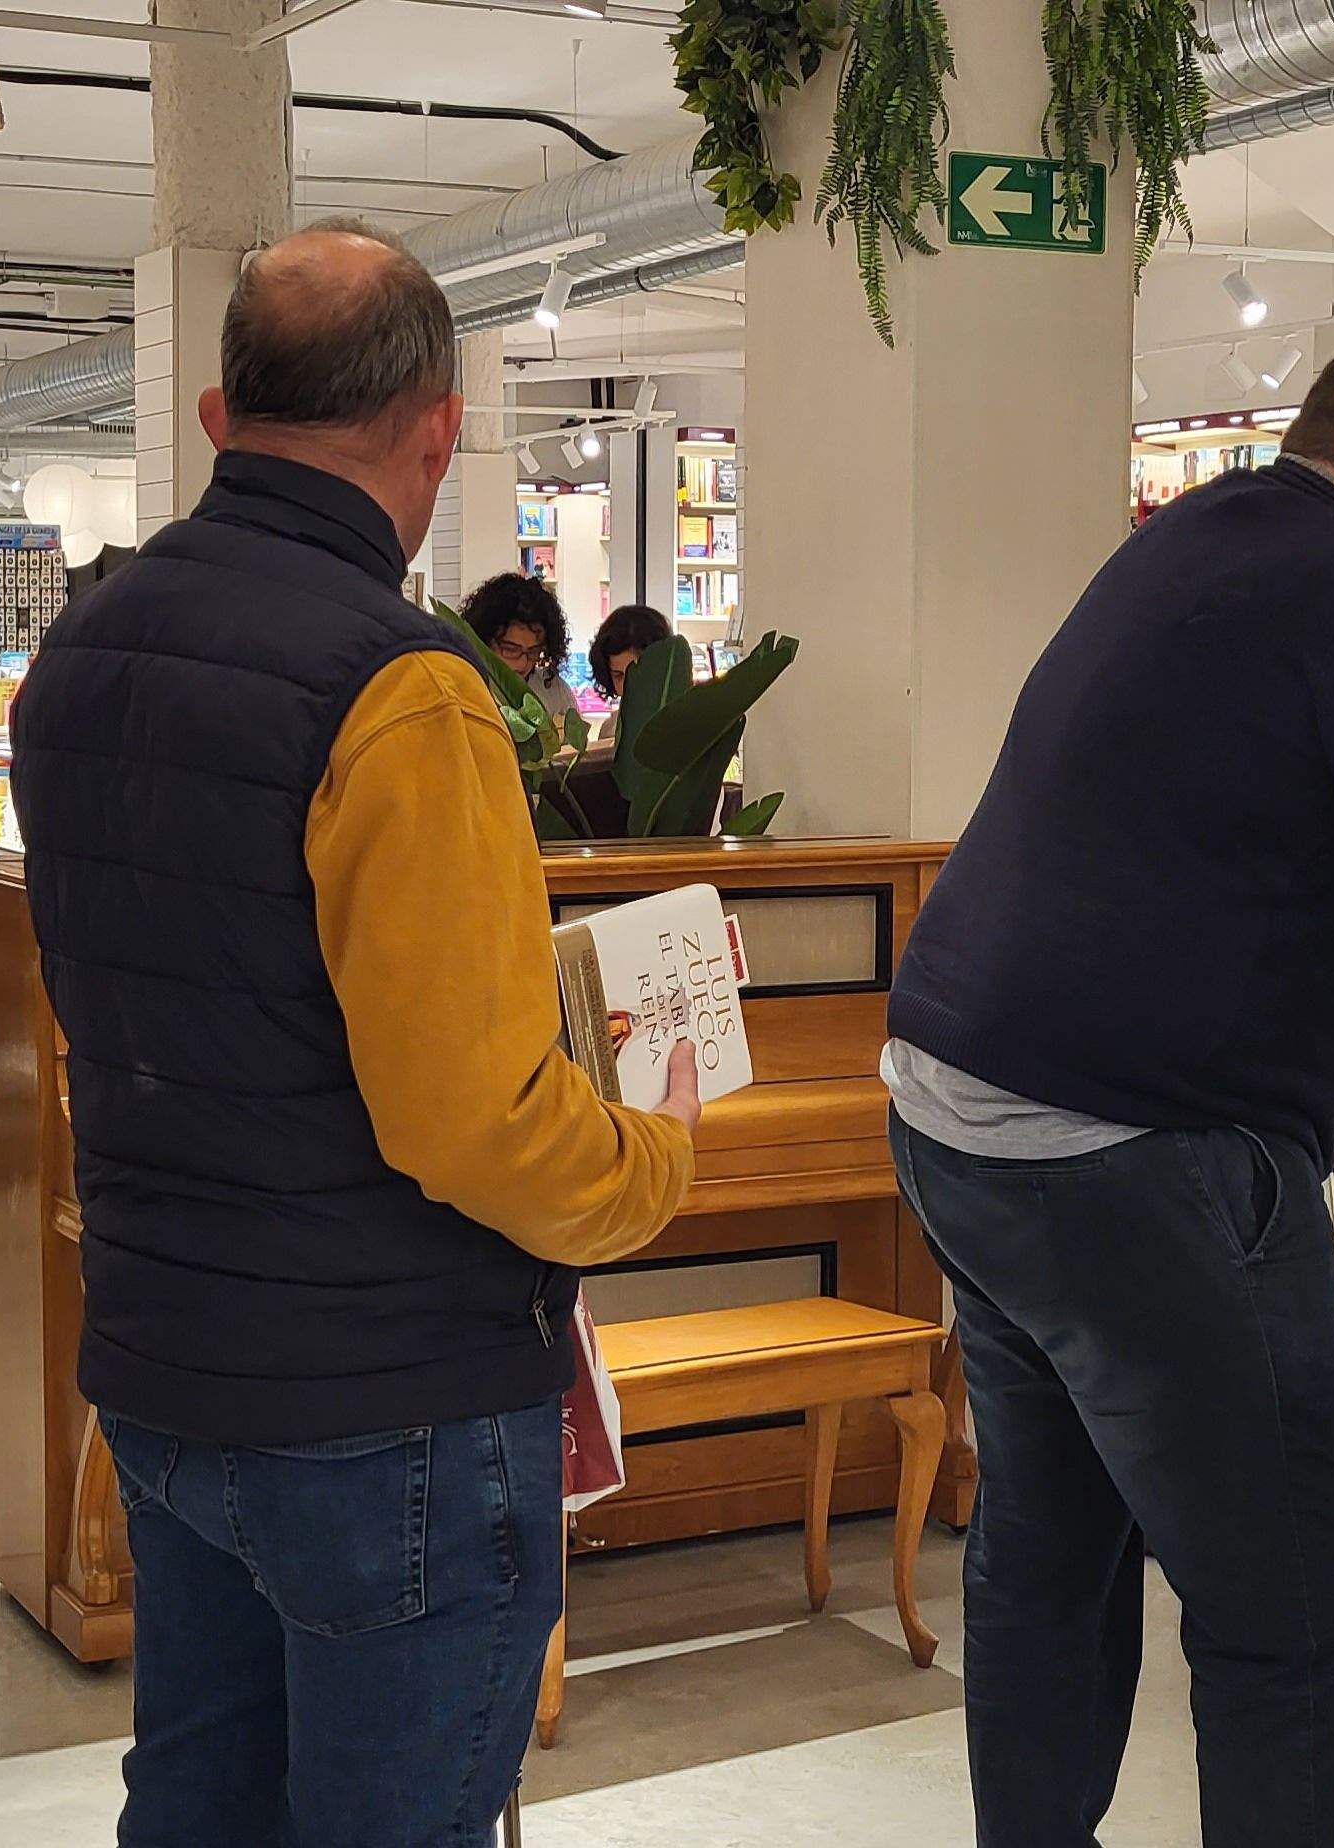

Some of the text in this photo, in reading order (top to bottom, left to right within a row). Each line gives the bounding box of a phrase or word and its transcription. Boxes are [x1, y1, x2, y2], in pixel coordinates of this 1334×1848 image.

[637, 972, 663, 1066] REINA
[658, 931, 689, 1042] EL TABL
[682, 931, 720, 1071] ZUECO
[706, 955, 736, 1037] LUIS
